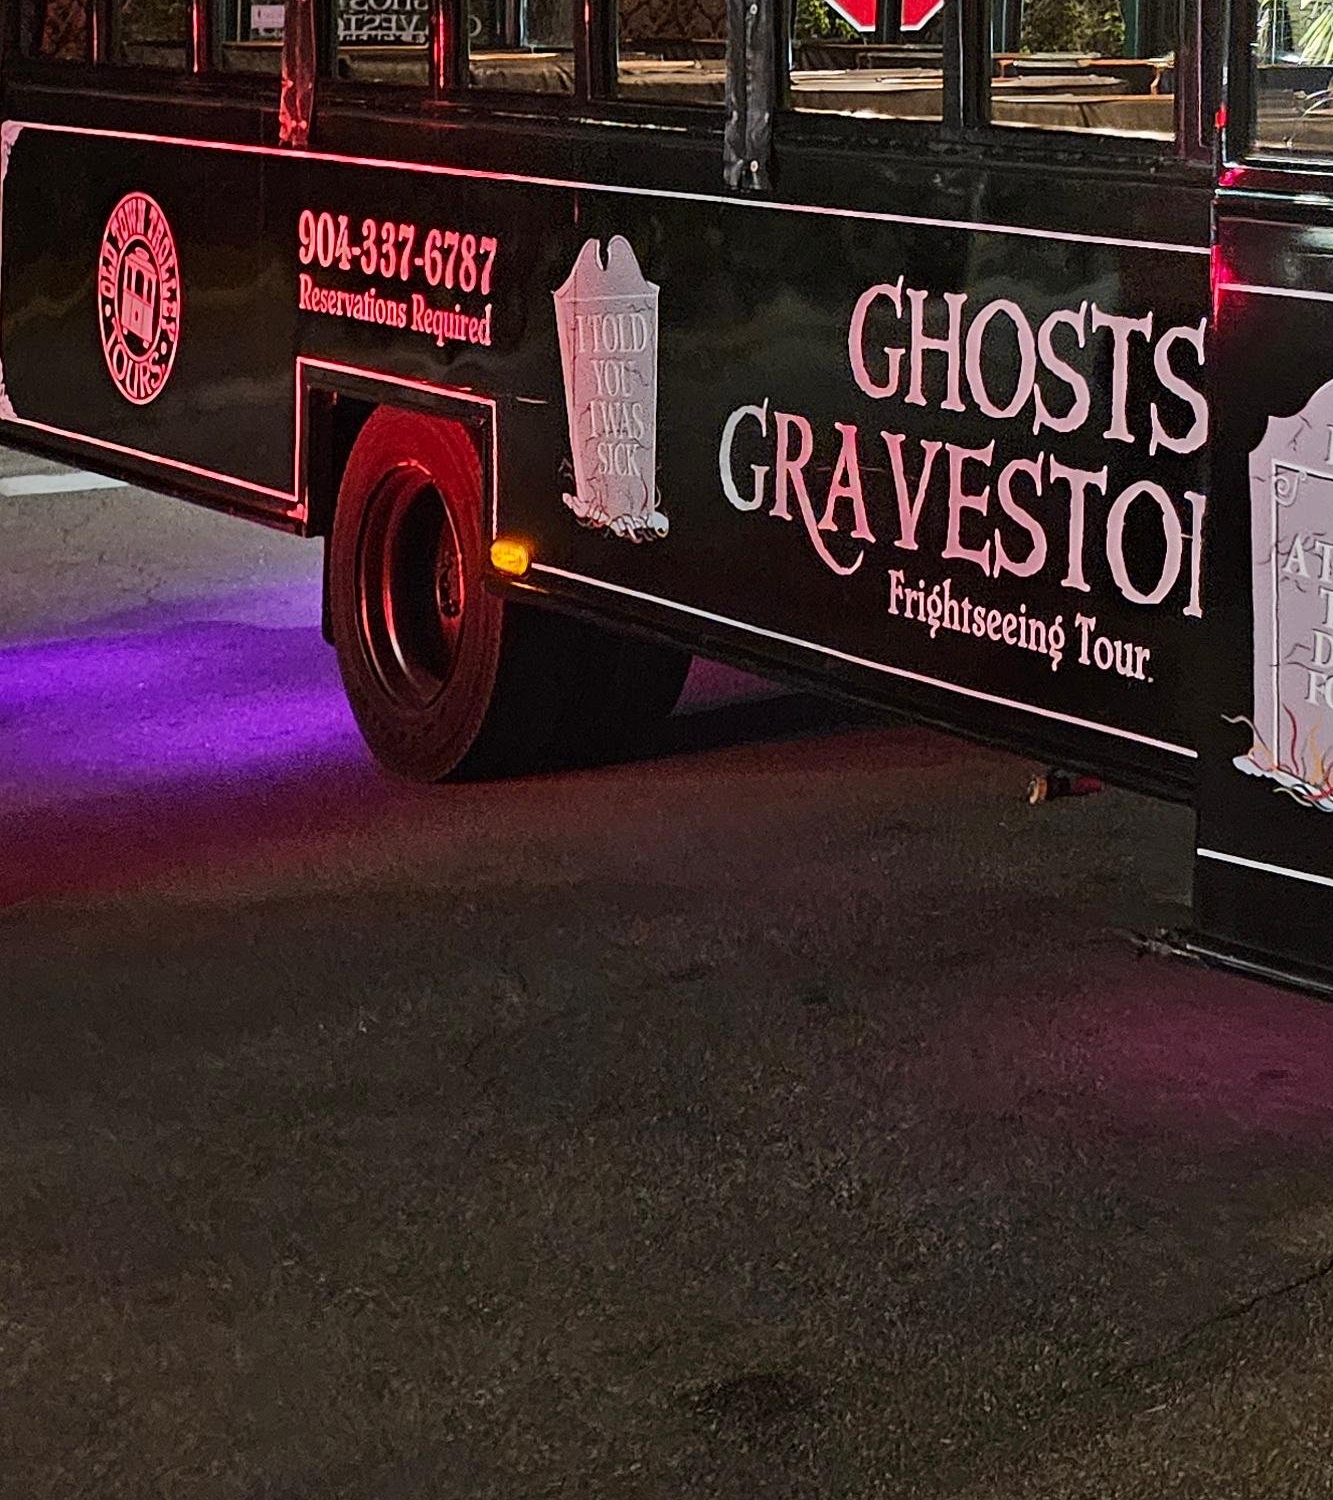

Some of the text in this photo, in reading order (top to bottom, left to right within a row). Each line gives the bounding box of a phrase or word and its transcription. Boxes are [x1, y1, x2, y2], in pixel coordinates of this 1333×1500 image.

[100, 198, 176, 342] OLD TOWN TROLLEY
[299, 209, 498, 296] 904-337-6787
[299, 273, 492, 347] Reservations Required
[587, 312, 648, 353] TOLD
[106, 316, 163, 397] TOURS
[590, 356, 637, 398] YOU
[848, 274, 1209, 456] GHOSTS
[601, 400, 645, 441] WAS
[597, 442, 643, 477] SICK
[1282, 531, 1310, 579] A
[887, 569, 1066, 672] Frightseeing
